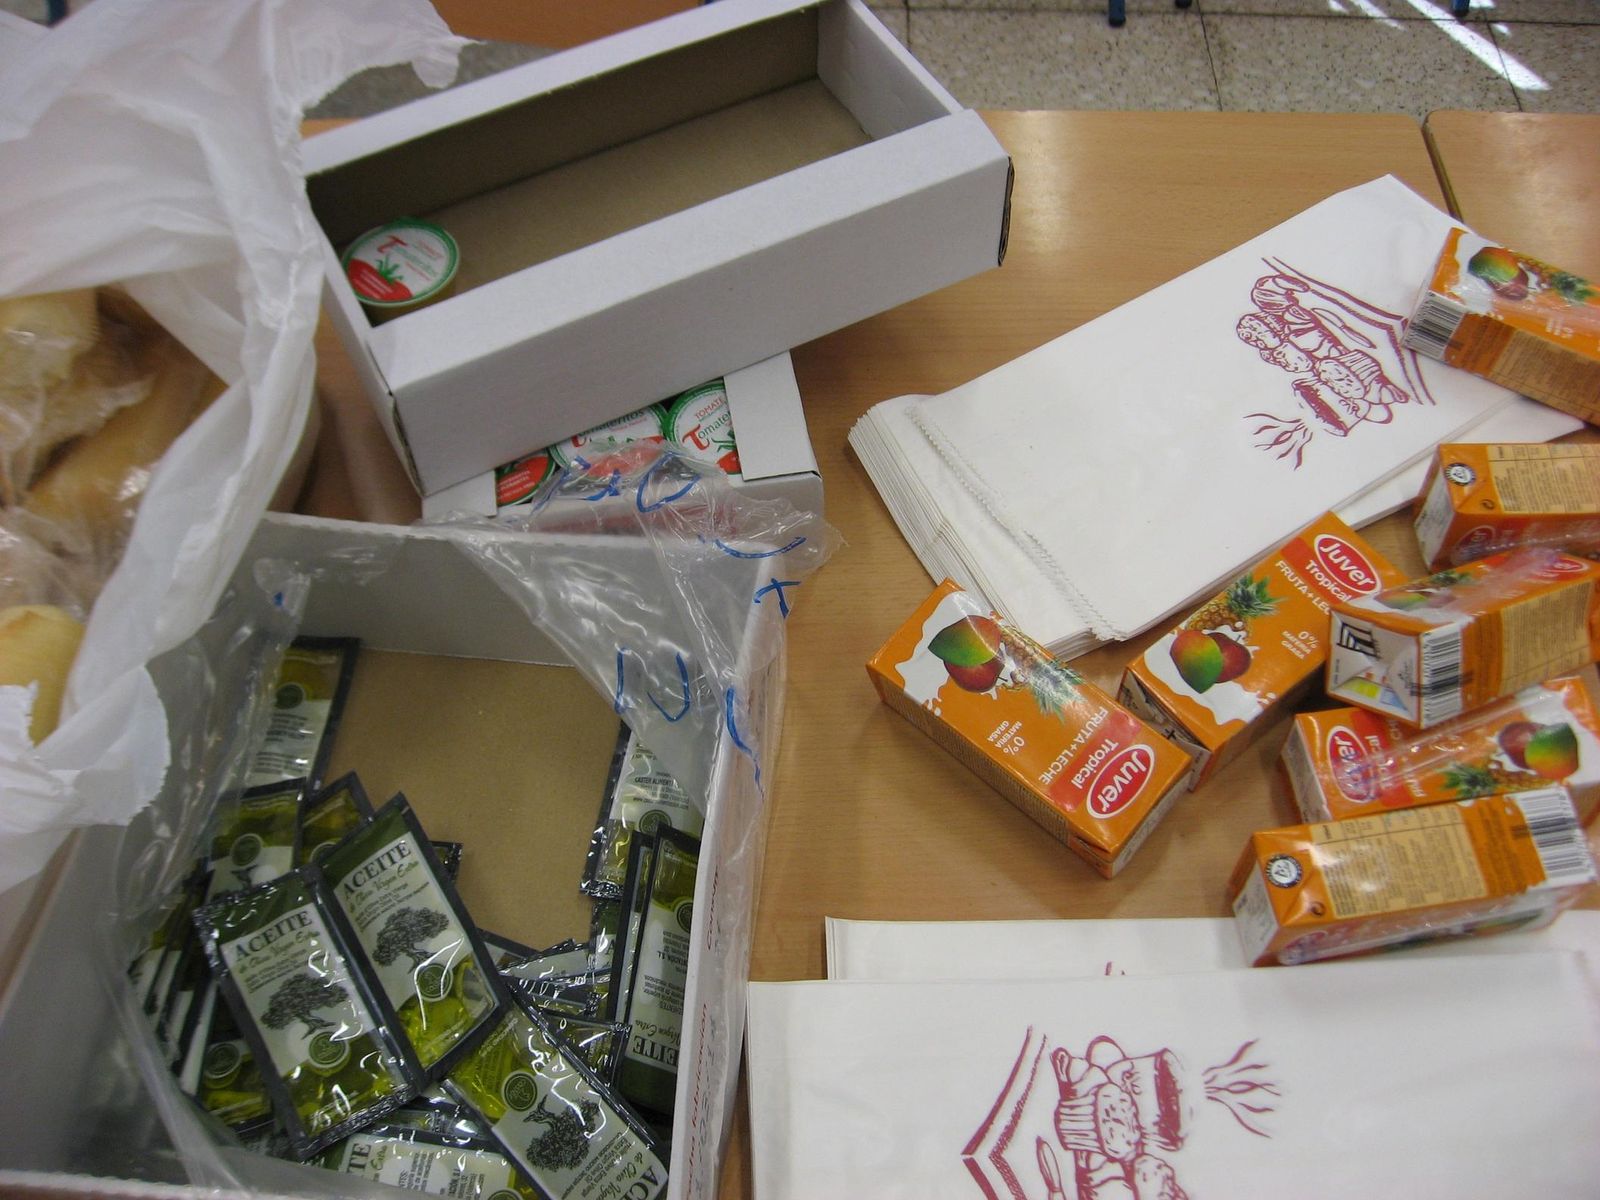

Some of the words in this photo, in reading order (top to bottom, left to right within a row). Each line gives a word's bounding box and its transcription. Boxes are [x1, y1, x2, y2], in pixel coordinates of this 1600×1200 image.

[1305, 560, 1352, 602] Tropical
[1319, 542, 1376, 586] Juver
[987, 720, 1009, 742] GRASA
[995, 721, 1022, 748] MATERIA
[1003, 736, 1025, 755] 0%
[1071, 738, 1119, 789] Tropical
[1097, 750, 1147, 812] Juver
[343, 842, 411, 900] ACEITE
[236, 911, 312, 960] ACEITE
[635, 1019, 658, 1037] Extra
[633, 1035, 680, 1066] EITE
